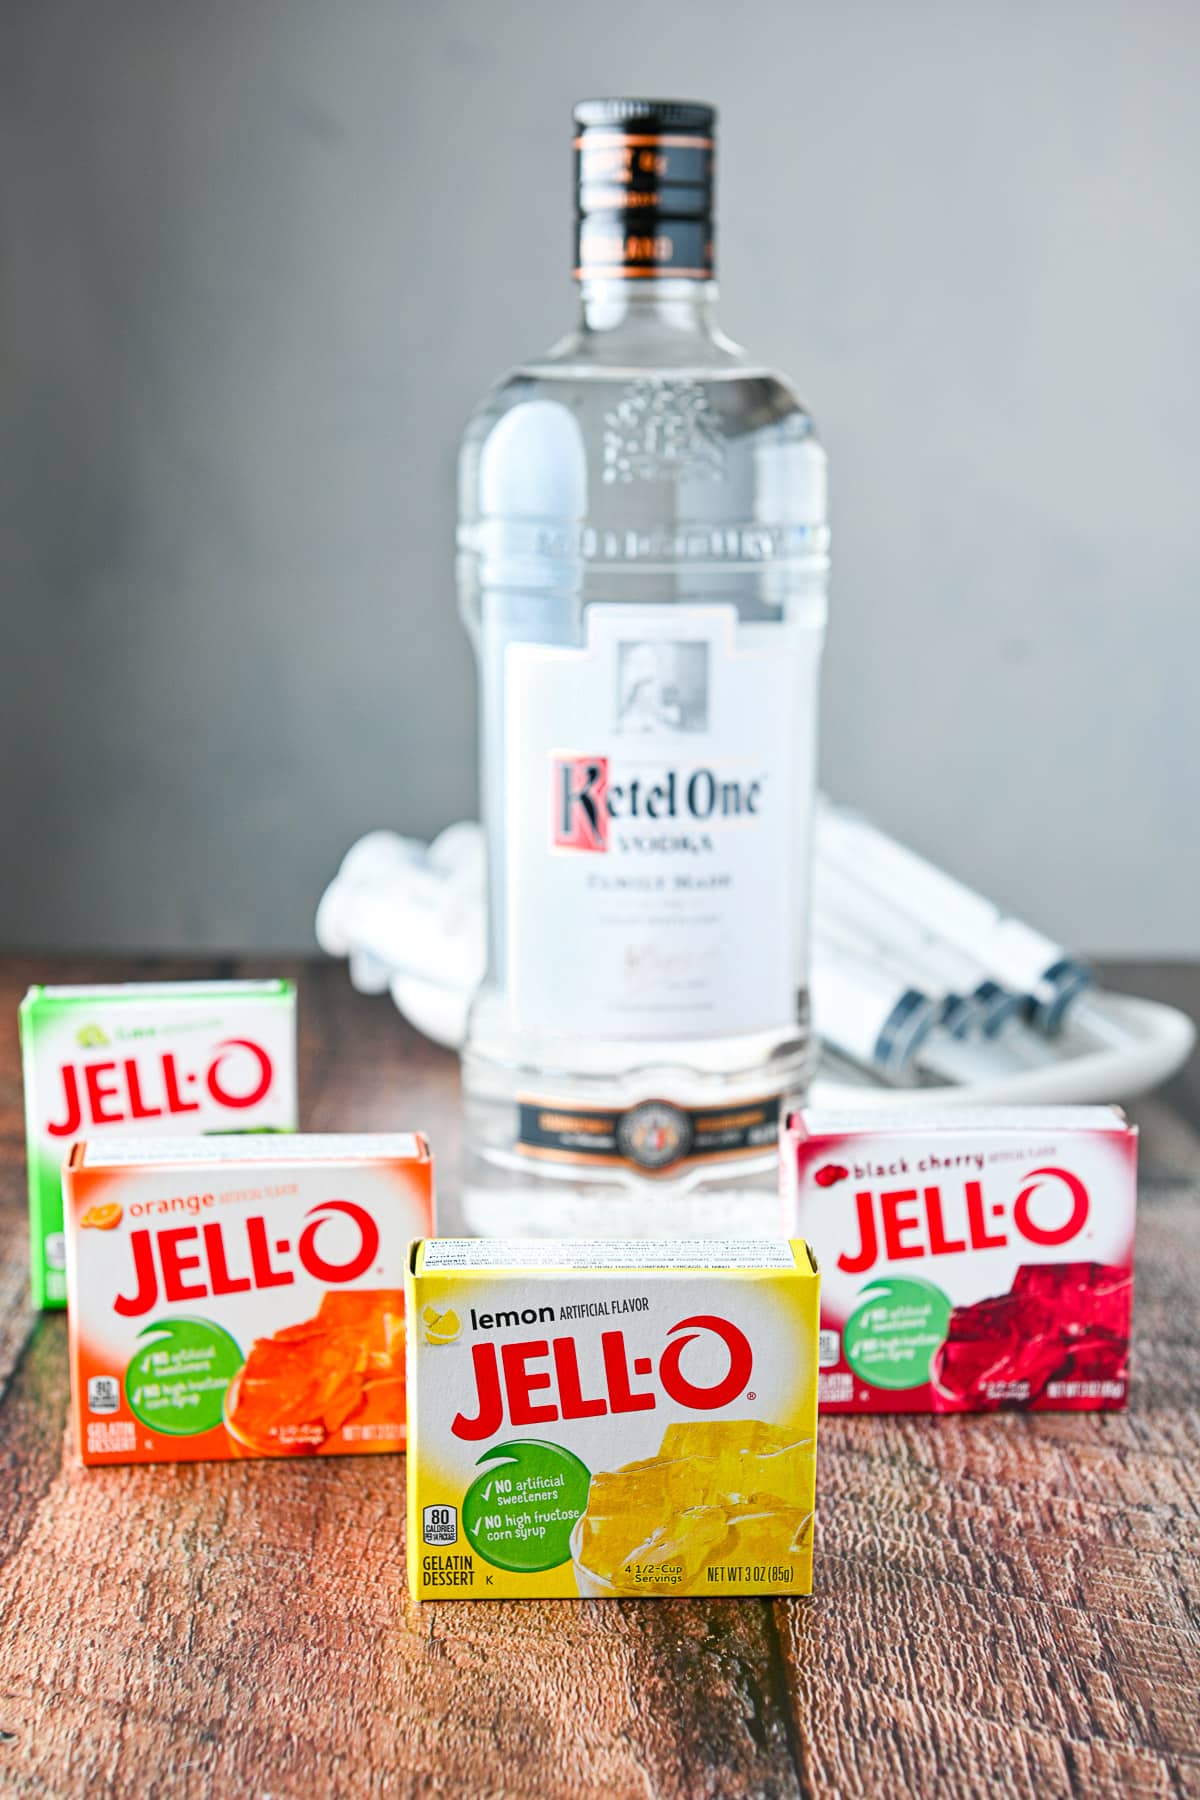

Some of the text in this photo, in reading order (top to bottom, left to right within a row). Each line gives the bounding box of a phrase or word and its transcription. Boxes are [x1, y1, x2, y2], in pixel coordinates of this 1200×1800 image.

[560, 763, 762, 844] Ketel One
[853, 1159, 910, 1179] black
[918, 1152, 984, 1173] cherry
[129, 1191, 215, 1217] orange
[470, 1297, 650, 1330] lemon ARTIFICIAL FLAVOR
[495, 1474, 565, 1493] NO artificial
[497, 1490, 558, 1506] sweeteners
[431, 1509, 450, 1525] 80
[485, 1508, 580, 1530] NO high fructose
[425, 1525, 455, 1533] CALORIES
[487, 1525, 546, 1541] corn syrup
[423, 1556, 473, 1571] GELATIN
[423, 1571, 494, 1586] DESSERT K
[624, 1564, 794, 1583] 4 1/2-Cup NET WT 3 OZ (85g)
[634, 1574, 682, 1585] Servings
